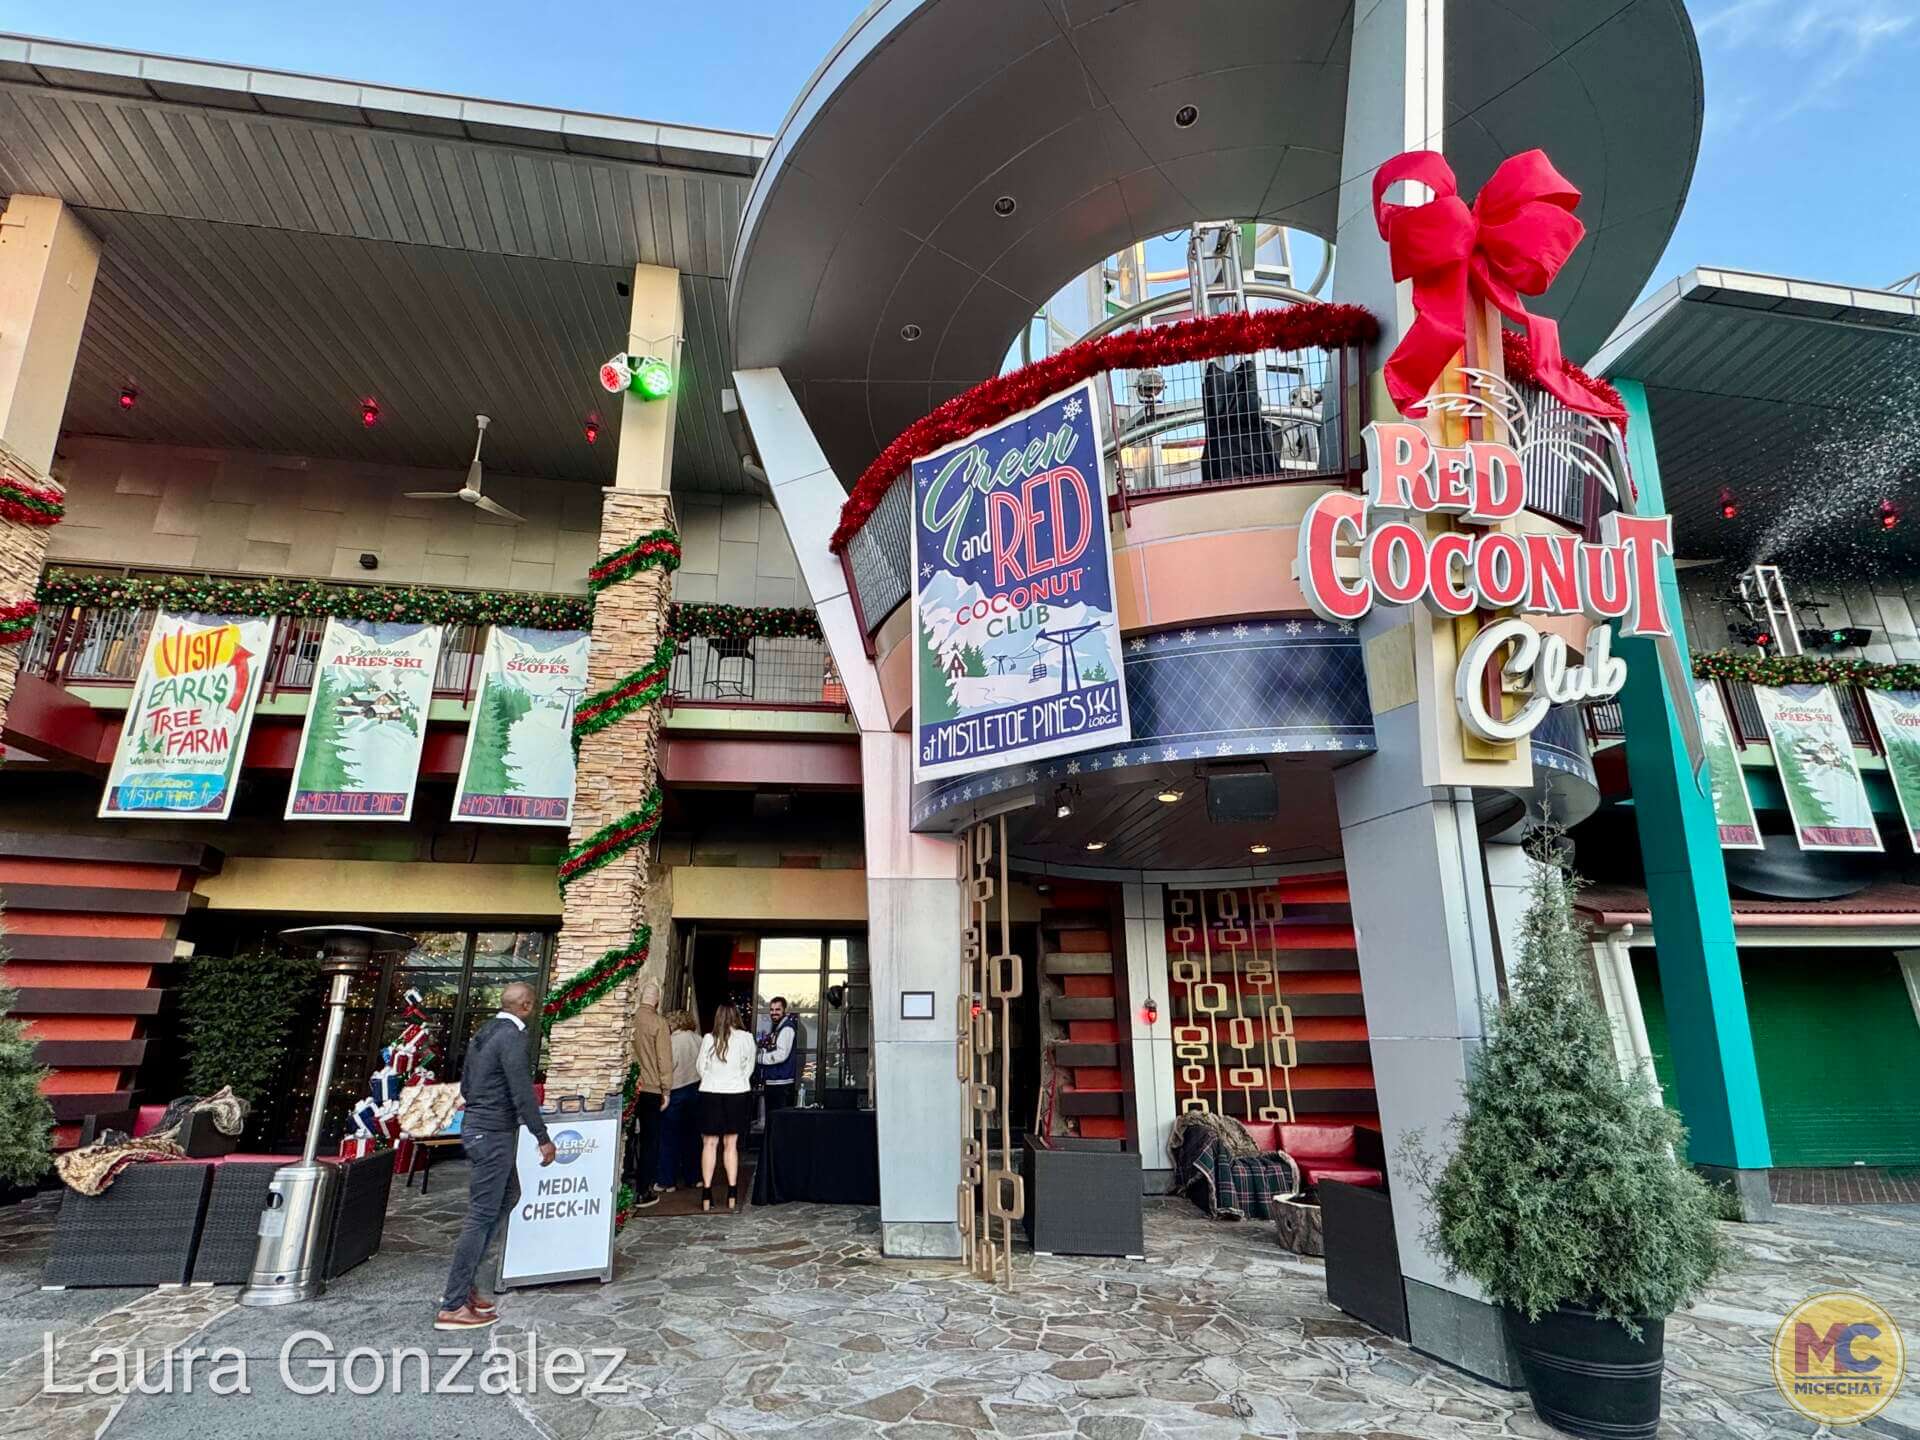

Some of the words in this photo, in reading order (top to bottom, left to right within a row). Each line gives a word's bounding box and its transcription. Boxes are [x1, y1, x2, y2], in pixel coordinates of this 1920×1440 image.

[1363, 421, 1526, 523] RED
[922, 422, 1079, 568] Green
[961, 495, 992, 565] and
[989, 465, 1095, 588] RED
[1298, 489, 1673, 639] COCONUT
[955, 567, 1084, 627] COCONUT
[986, 605, 1050, 639] CLUB
[162, 625, 230, 676] VISIT
[332, 655, 424, 669] APRES-SKI
[348, 645, 411, 657] Experience
[511, 652, 546, 666] Enjoy
[549, 654, 567, 665] the
[506, 660, 569, 674] SLOPES
[1455, 616, 1628, 745] Club
[147, 673, 228, 710] EARL'S
[147, 709, 202, 735] TREE
[923, 733, 937, 763] at
[937, 706, 1029, 762] MISTLETOE
[1033, 693, 1089, 742] PINES
[1086, 687, 1117, 719] SKI
[1088, 712, 1118, 728] LODGE
[167, 728, 228, 757] FARM
[305, 793, 369, 813] MISTLETOE
[370, 793, 405, 813] PINES
[471, 795, 530, 816] MISTLETOE
[532, 799, 566, 818] PINES
[554, 1137, 600, 1149] VERSAL
[537, 1176, 589, 1196] MEDIA
[522, 1198, 600, 1221] CHECK-IN
